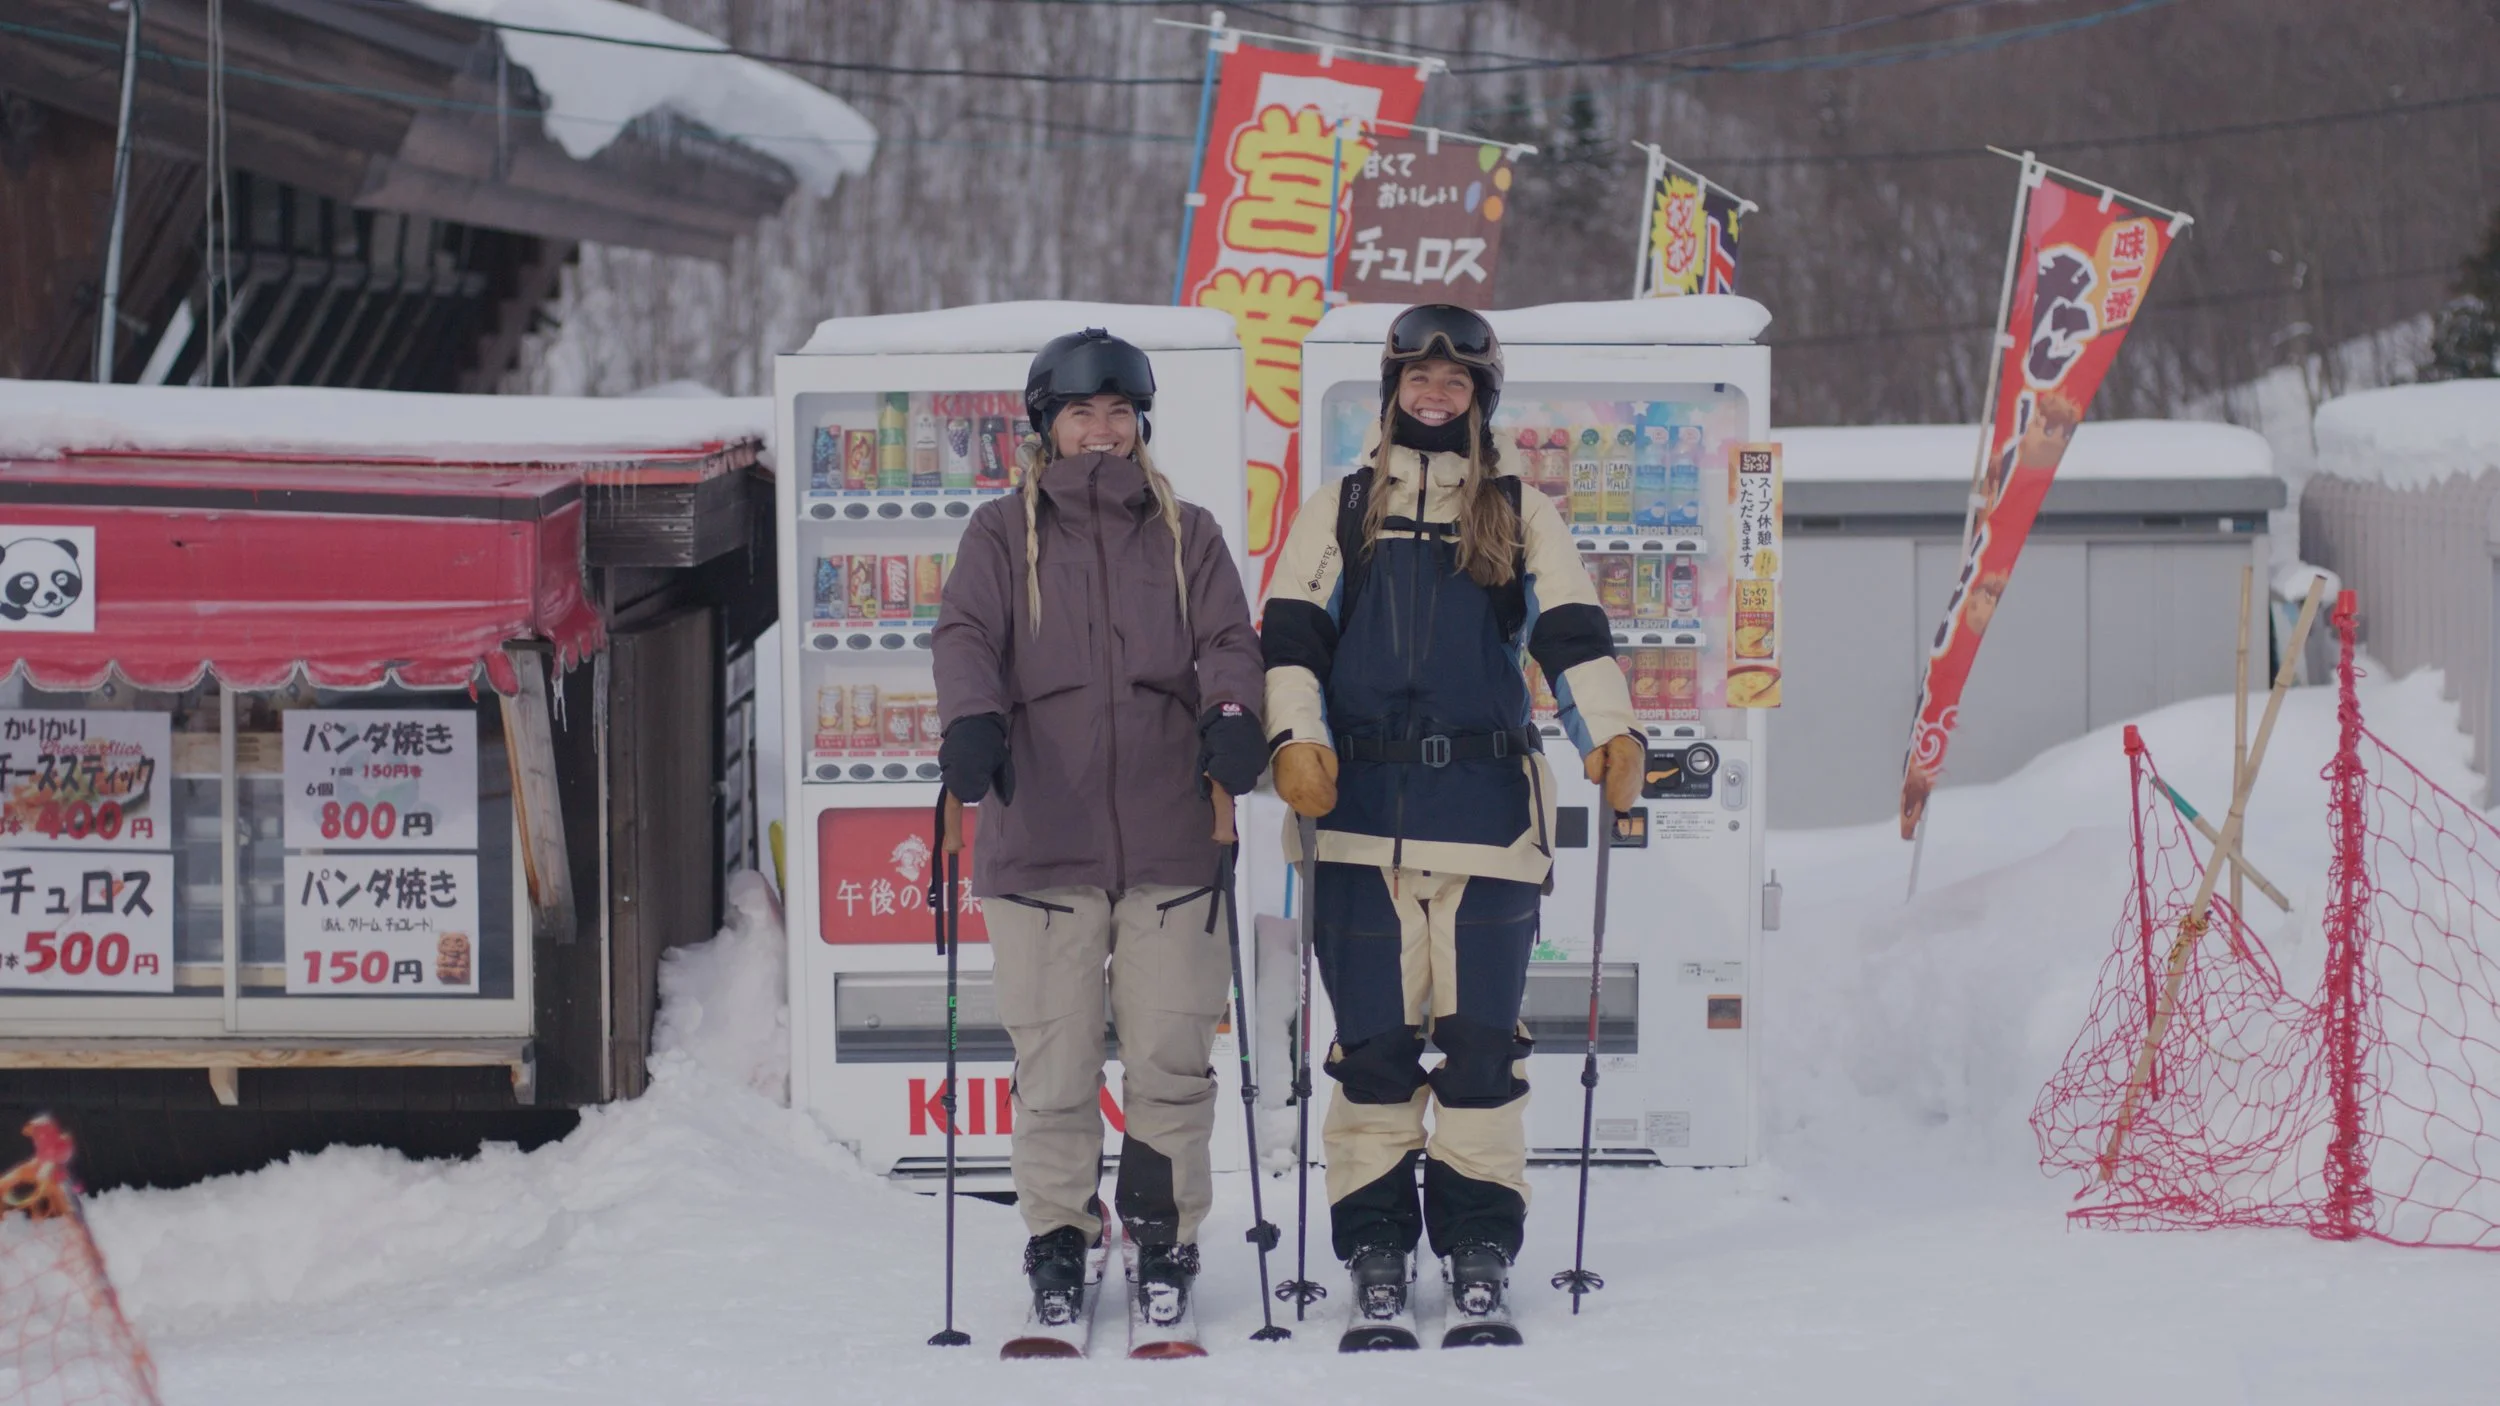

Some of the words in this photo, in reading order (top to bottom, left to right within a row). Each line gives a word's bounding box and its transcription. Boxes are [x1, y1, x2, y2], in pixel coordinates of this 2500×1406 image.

[1363, 151, 1416, 179] 甘くて
[1377, 182, 1459, 209] おいしい
[1350, 226, 1487, 284] チュロス
[2105, 226, 2145, 322] 味一番
[1739, 477, 1755, 571] いただきます。
[1757, 476, 1773, 545] スープ休憩
[5, 717, 86, 740] かりかり
[303, 720, 453, 756] パンダ焼き
[306, 783, 334, 796] 6個
[320, 801, 434, 839] 800円
[0, 866, 153, 917] チュロス
[301, 867, 457, 909] パンダ焼き
[303, 950, 423, 984] 150円
